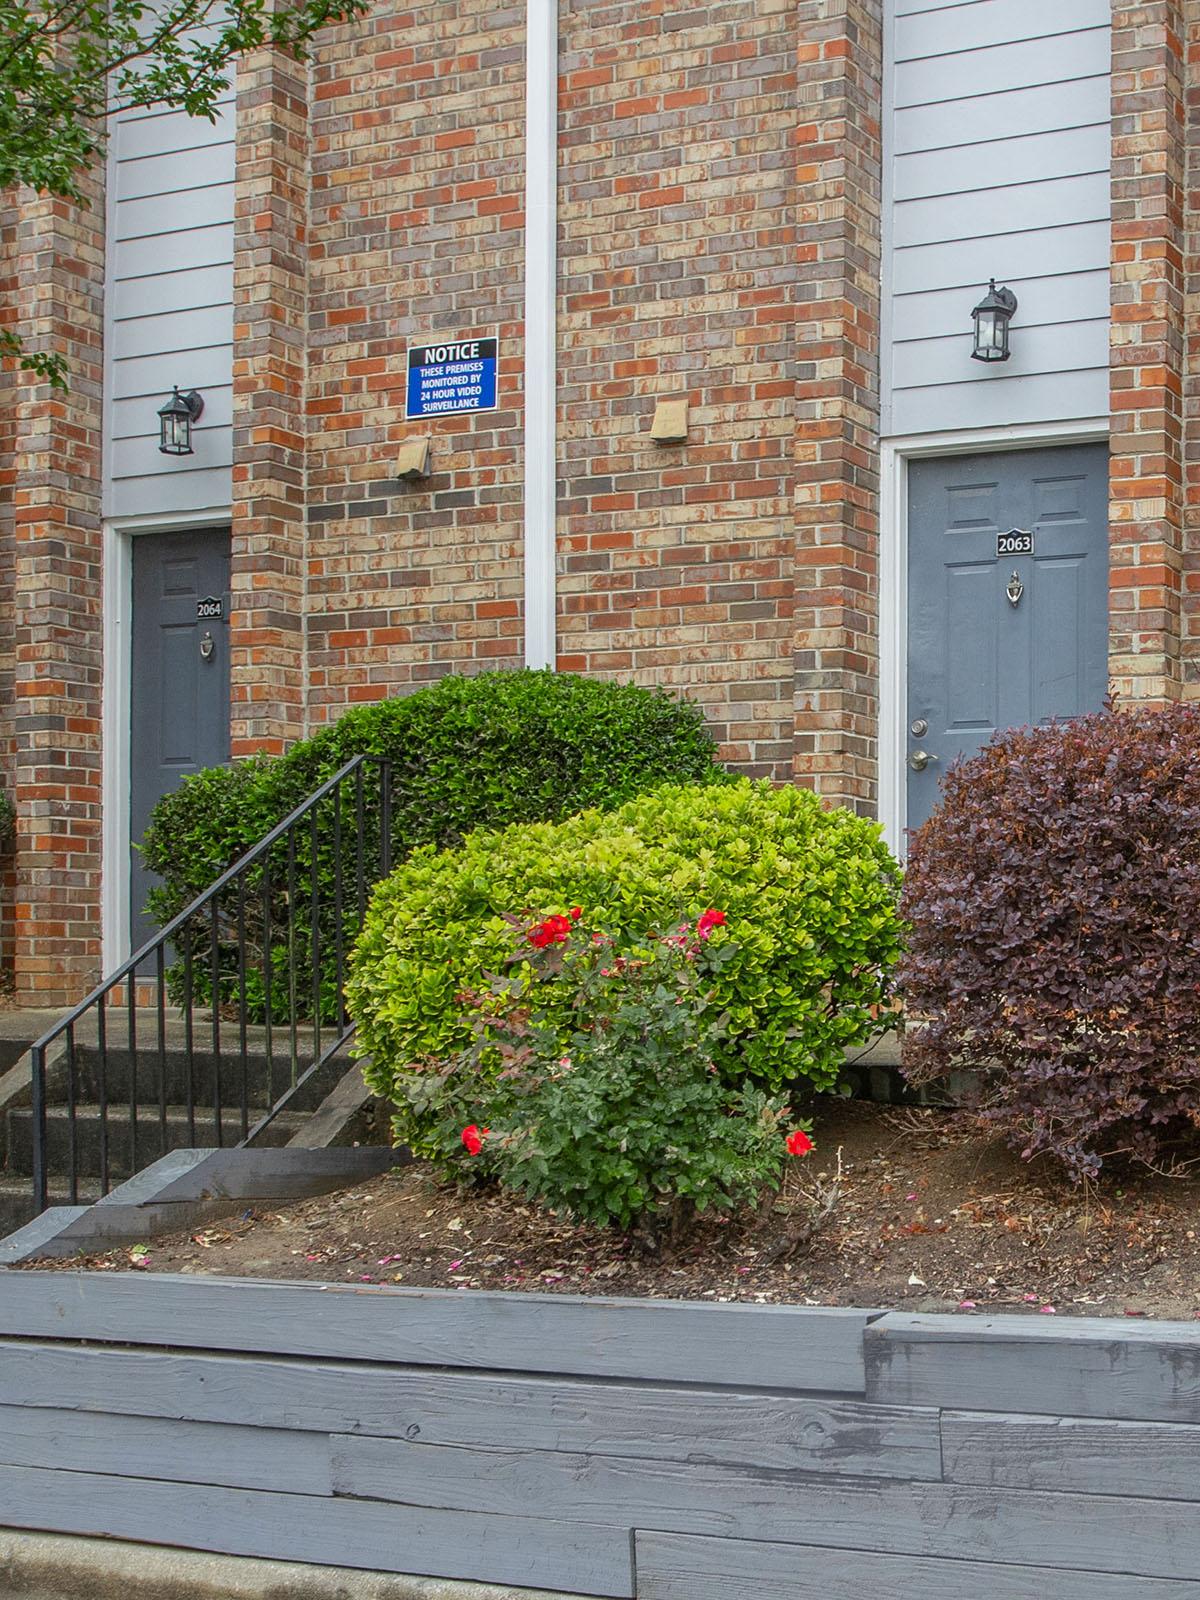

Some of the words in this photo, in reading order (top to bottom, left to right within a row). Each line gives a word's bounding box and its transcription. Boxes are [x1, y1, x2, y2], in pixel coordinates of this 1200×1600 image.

[424, 343, 480, 364] NOTICE
[420, 366, 444, 378] THESE
[445, 361, 484, 375] PREMISES
[421, 375, 469, 389] MONITORED
[470, 374, 482, 384] BY
[420, 392, 430, 401] 24
[432, 389, 455, 399] HOUR
[457, 386, 482, 397] VIDEO
[422, 397, 480, 413] SURVEILLANCE
[998, 536, 1031, 552] 2063
[198, 603, 221, 616] 2064
